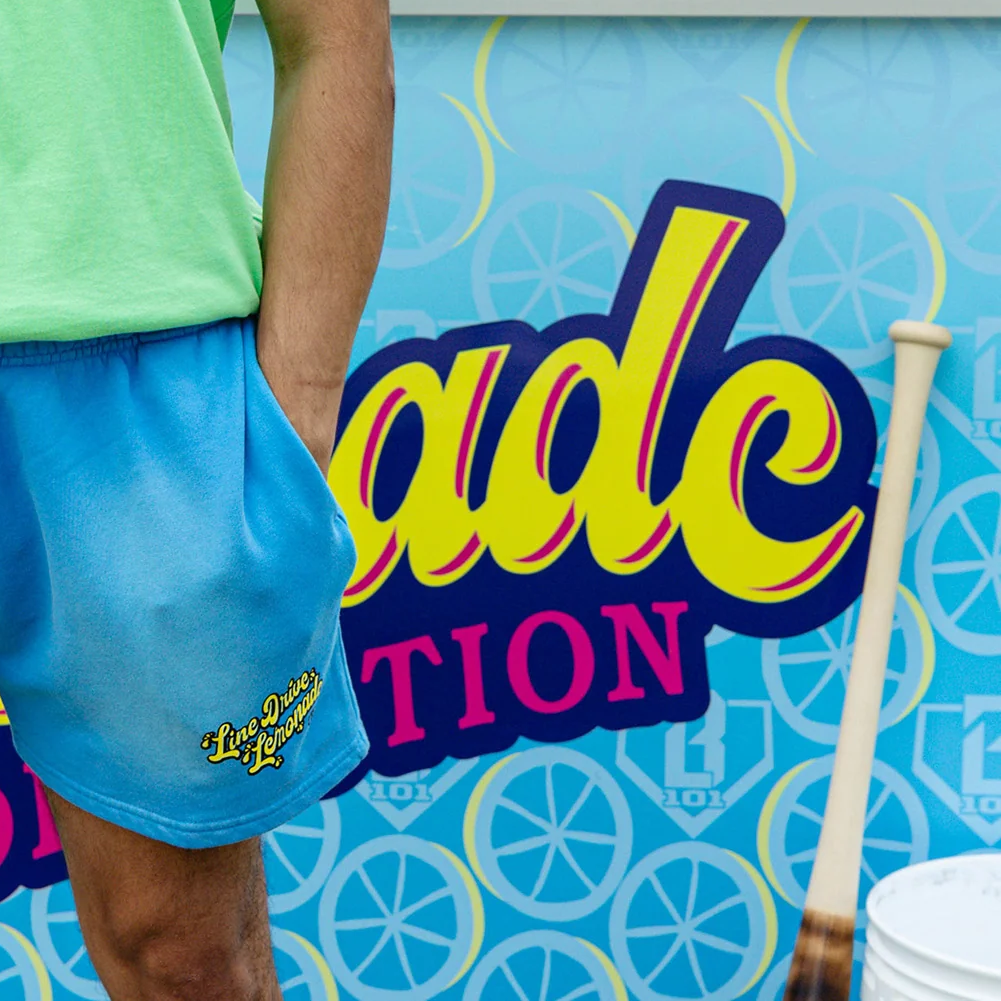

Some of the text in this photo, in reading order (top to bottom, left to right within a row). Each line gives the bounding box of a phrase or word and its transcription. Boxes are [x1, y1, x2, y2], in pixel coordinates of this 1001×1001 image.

[206, 668, 312, 766] Line Drive
[369, 782, 432, 802] 101
[661, 788, 727, 808] 101
[960, 796, 1000, 815] 10
